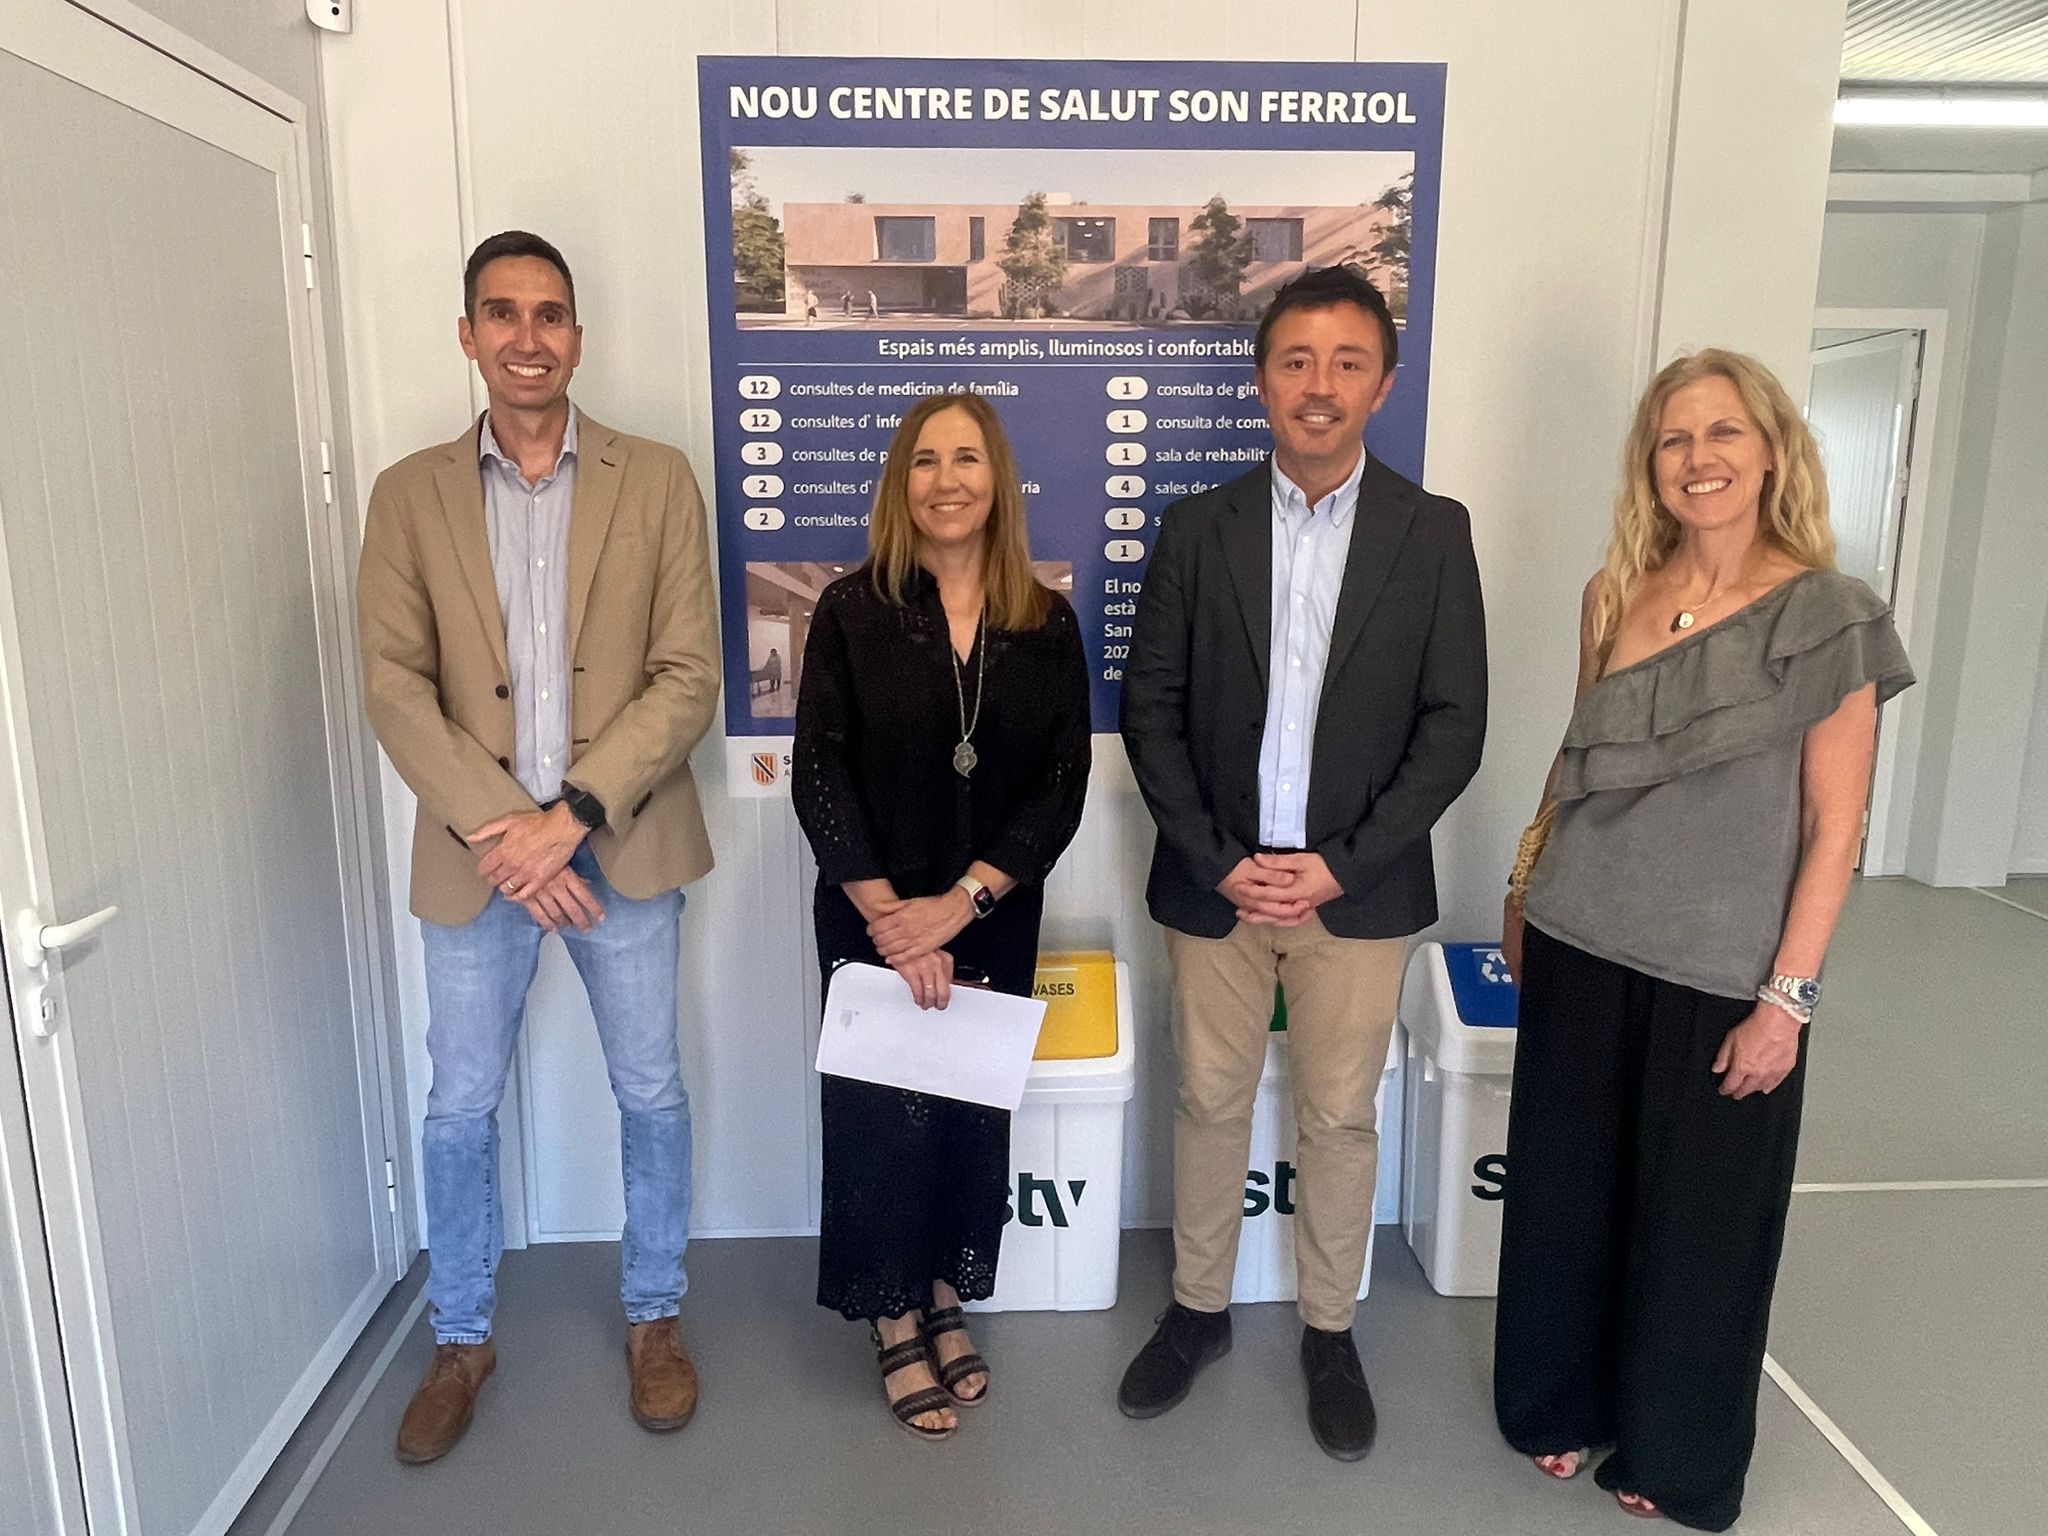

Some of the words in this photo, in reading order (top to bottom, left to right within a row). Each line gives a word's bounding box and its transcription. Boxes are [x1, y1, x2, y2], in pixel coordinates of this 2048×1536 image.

[729, 86, 819, 119] NOU
[828, 87, 973, 120] CENTRE
[983, 88, 1031, 121] DE
[1039, 88, 1160, 122] SALUT
[1168, 89, 1249, 123] SON
[1260, 91, 1417, 124] FERRIOL
[878, 338, 935, 360] Espais
[939, 336, 976, 356] més
[979, 338, 1045, 360] amplis,
[1049, 338, 1144, 357] lluminosos
[1148, 338, 1153, 356] i
[750, 381, 769, 395] 12
[790, 382, 854, 396] consultes
[857, 382, 875, 396] de
[878, 382, 944, 396] medicina
[948, 382, 967, 395] de
[969, 380, 1020, 396] família
[1122, 382, 1132, 395] 1
[1156, 382, 1214, 396] consulta
[1216, 382, 1234, 396] de
[751, 414, 770, 427] 12
[791, 414, 855, 428] consultes
[1122, 415, 1131, 428] 1
[1155, 415, 1212, 429] consulta
[1215, 415, 1233, 429] de
[757, 447, 767, 460] 3
[792, 448, 857, 462] consultes
[859, 448, 877, 462] de
[1121, 448, 1131, 461] 1
[1155, 448, 1182, 462] sala
[1185, 448, 1203, 462] de
[1205, 448, 1270, 462] rehabilit
[758, 480, 768, 493] 2
[793, 481, 857, 495] consultes
[1120, 480, 1130, 493] 4
[1155, 481, 1188, 495] sales
[1190, 481, 1208, 495] de
[759, 513, 769, 526] 2
[794, 514, 858, 527] consultes
[1121, 513, 1129, 526] 1
[1121, 544, 1129, 557] 1
[1104, 578, 1119, 594] El
[1104, 599, 1137, 616] està
[1103, 666, 1123, 681] de
